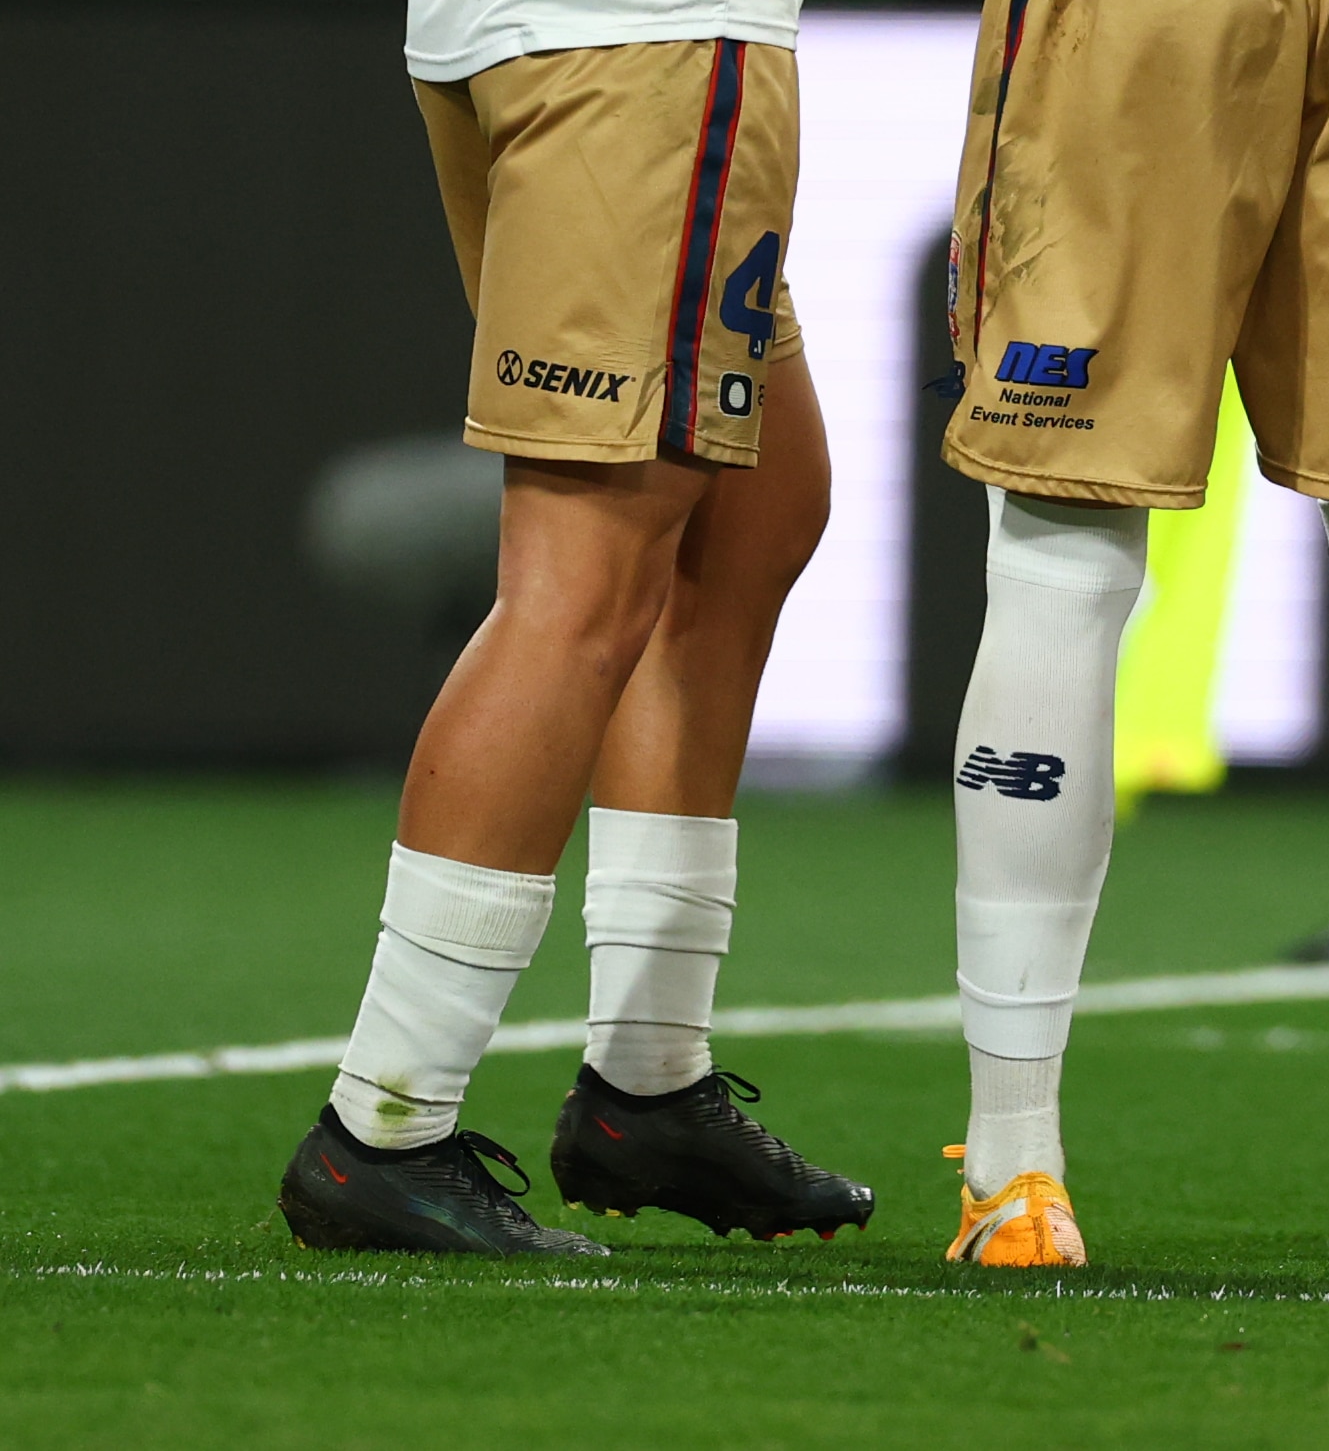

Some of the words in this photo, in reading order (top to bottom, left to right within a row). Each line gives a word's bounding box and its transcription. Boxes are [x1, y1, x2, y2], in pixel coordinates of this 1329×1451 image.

[523, 358, 630, 403] SENIX
[999, 387, 1072, 408] National
[970, 405, 1018, 427] Event
[1022, 412, 1095, 430] Services
